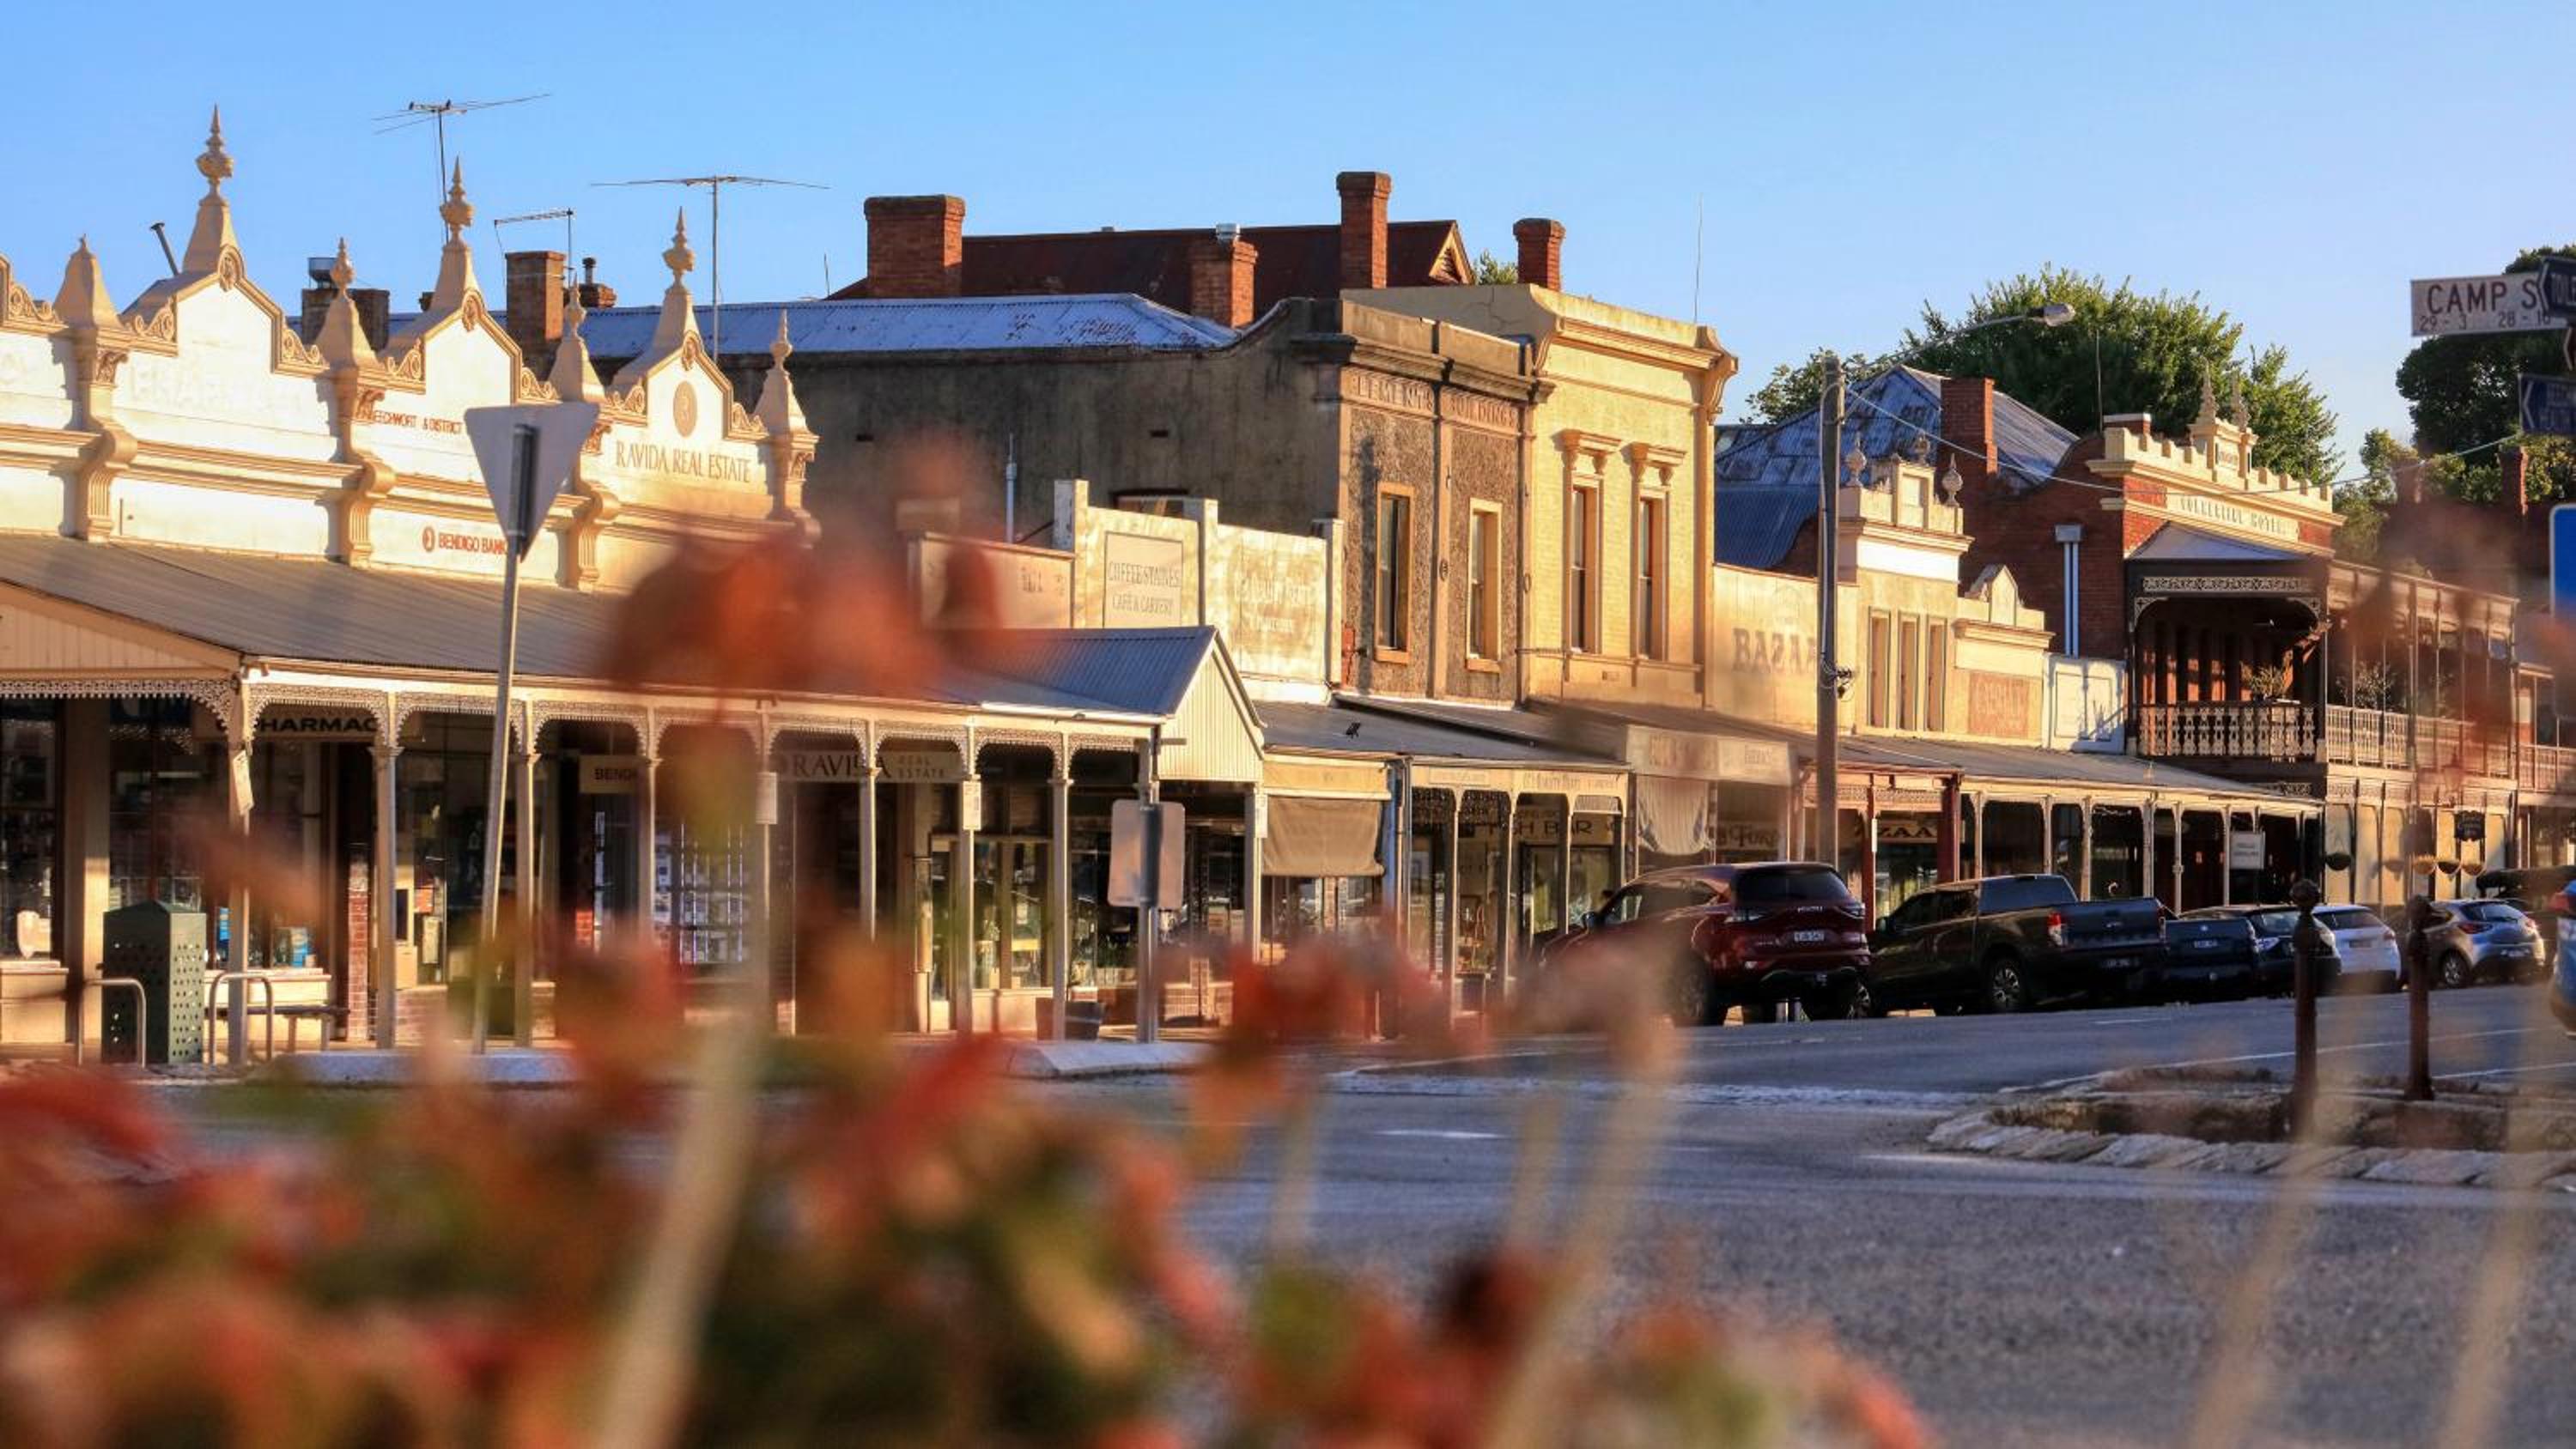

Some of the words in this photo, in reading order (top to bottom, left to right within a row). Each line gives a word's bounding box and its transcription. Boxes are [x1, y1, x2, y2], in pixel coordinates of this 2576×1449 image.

[2427, 281, 2507, 315] CAMP
[2521, 279, 2538, 310] S
[2419, 314, 2438, 332] 29
[2459, 314, 2467, 330] 3
[2498, 311, 2516, 328] 28
[617, 439, 670, 475] RAVIDA
[671, 446, 704, 478] REAL
[708, 453, 750, 483] ESTATE
[439, 532, 479, 552] BENDIGO
[1733, 627, 1817, 675] BAZAA
